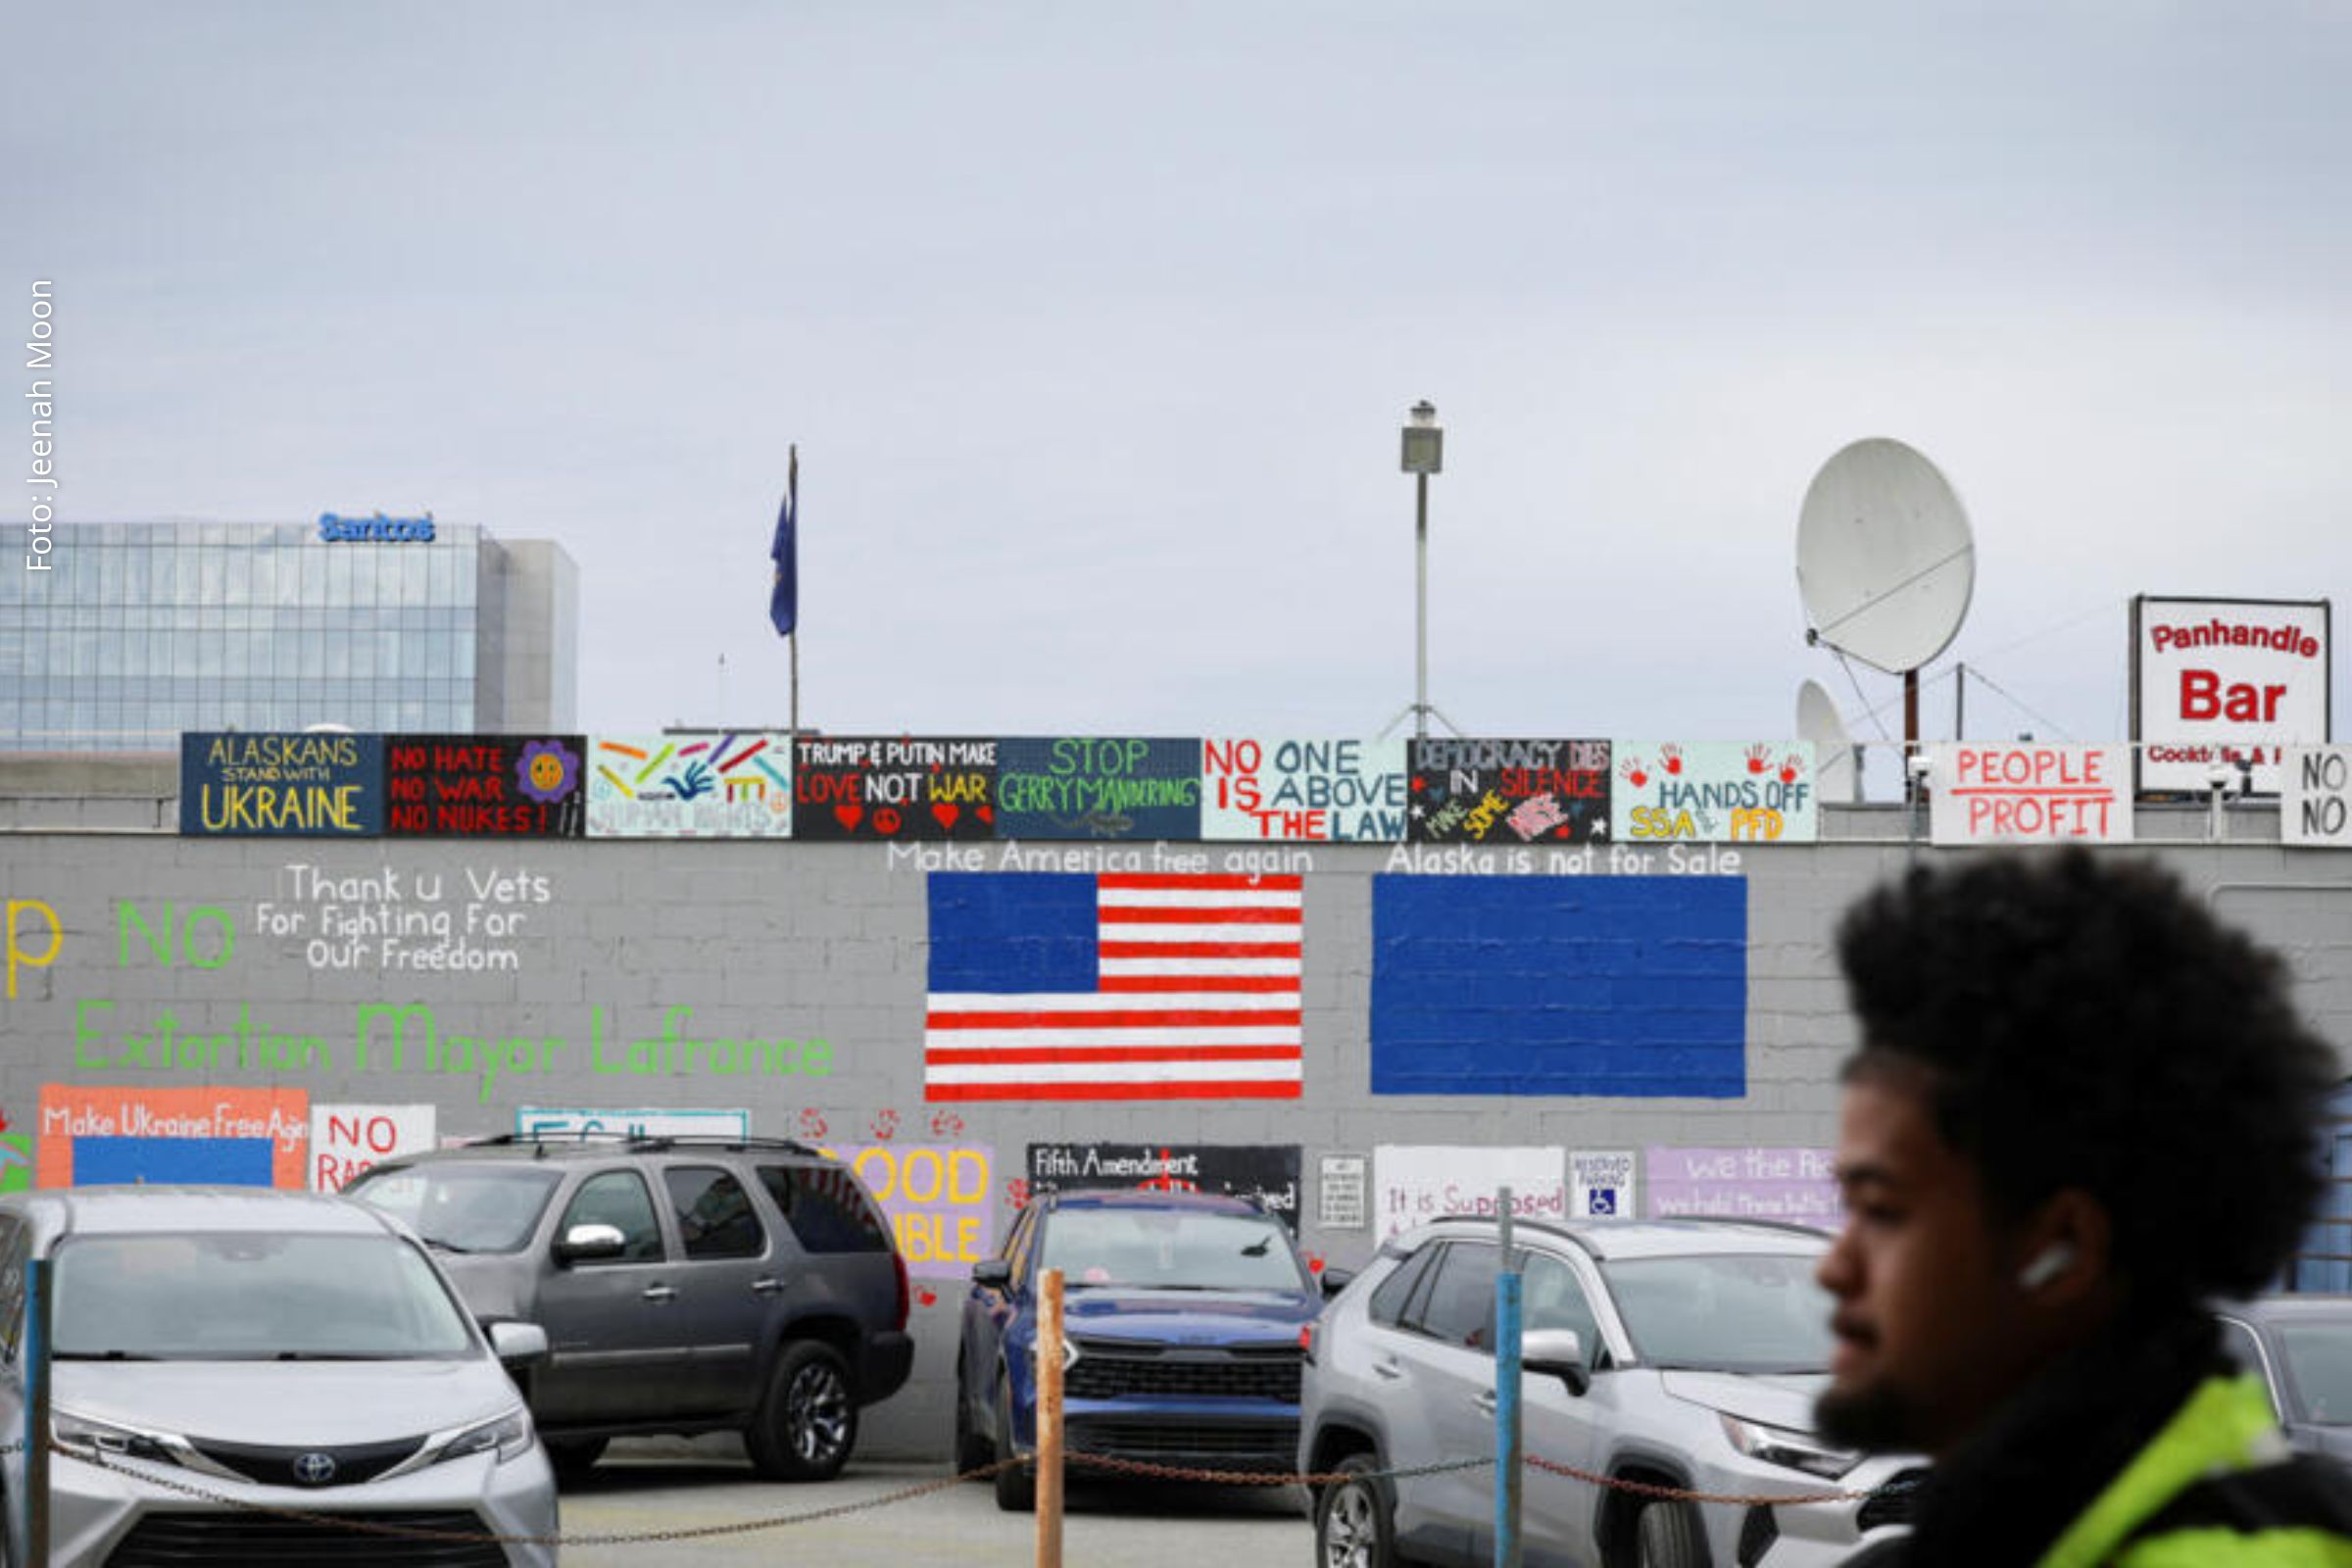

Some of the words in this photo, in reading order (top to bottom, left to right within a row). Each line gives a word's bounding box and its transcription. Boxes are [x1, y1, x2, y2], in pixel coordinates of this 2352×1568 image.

[2151, 617, 2320, 659] Panhandle
[2180, 668, 2286, 722] Bar
[208, 737, 358, 766] ALASKANS
[392, 746, 425, 771] NO
[435, 745, 504, 772] HATE
[799, 743, 866, 765] TRUMP
[886, 742, 945, 766] PUTIN
[949, 742, 998, 765] MAKE
[1049, 739, 1150, 775] STOP
[1204, 739, 1262, 775] NO
[1275, 740, 1360, 774] ONE
[1416, 741, 1562, 770] DEMOCRACY
[1570, 742, 1610, 771] DIES
[1958, 749, 2104, 784] PEOPLE
[221, 766, 280, 782] STAND
[282, 766, 330, 781] WITH
[392, 776, 425, 802] NO
[433, 775, 504, 802] WAR
[796, 773, 861, 804] LOVE
[864, 773, 923, 804] NOT
[927, 772, 987, 804] WAR
[1450, 769, 1479, 794] IN
[1500, 768, 1605, 799] SILENCE
[2302, 752, 2347, 792] NO
[202, 783, 364, 830] UKRAINE
[1218, 776, 1261, 812] IS
[1272, 773, 1408, 808] ABOVE
[1659, 780, 1759, 810] HANDS
[1765, 781, 1809, 812] OFF
[392, 806, 428, 832] NO
[1250, 809, 1326, 840] THE
[1331, 809, 1406, 840] LAW
[1630, 806, 1695, 839] SSA
[1730, 807, 1783, 841] PFD
[1969, 796, 2114, 838] PROFIT
[2302, 796, 2347, 836] NO
[888, 841, 984, 871] Make
[998, 840, 1142, 871] America
[1152, 843, 1208, 871] free
[1225, 848, 1313, 884] again
[1386, 842, 1495, 873] Alaska
[1507, 847, 1534, 872] is
[1548, 845, 1593, 873] not
[1608, 845, 1656, 873] for
[1667, 845, 1741, 873] Sale
[286, 863, 400, 902] Thank
[416, 874, 441, 902] u
[466, 867, 550, 903] Vets
[118, 899, 236, 968] NO
[257, 903, 306, 935] For
[321, 903, 451, 949] Fighting
[466, 903, 526, 937] For
[307, 938, 369, 968] Our
[382, 935, 518, 969] Freedom
[74, 999, 331, 1070] Extortion
[357, 1003, 567, 1103] Mayor
[591, 1004, 835, 1077] Lafrance
[44, 1106, 115, 1136] Make
[122, 1102, 211, 1138] Ukraine
[214, 1102, 268, 1138] Free
[328, 1115, 396, 1152] NO
[817, 1147, 989, 1204] OOD
[1036, 1148, 1078, 1175] Fifth
[1083, 1148, 1199, 1175] Amendment
